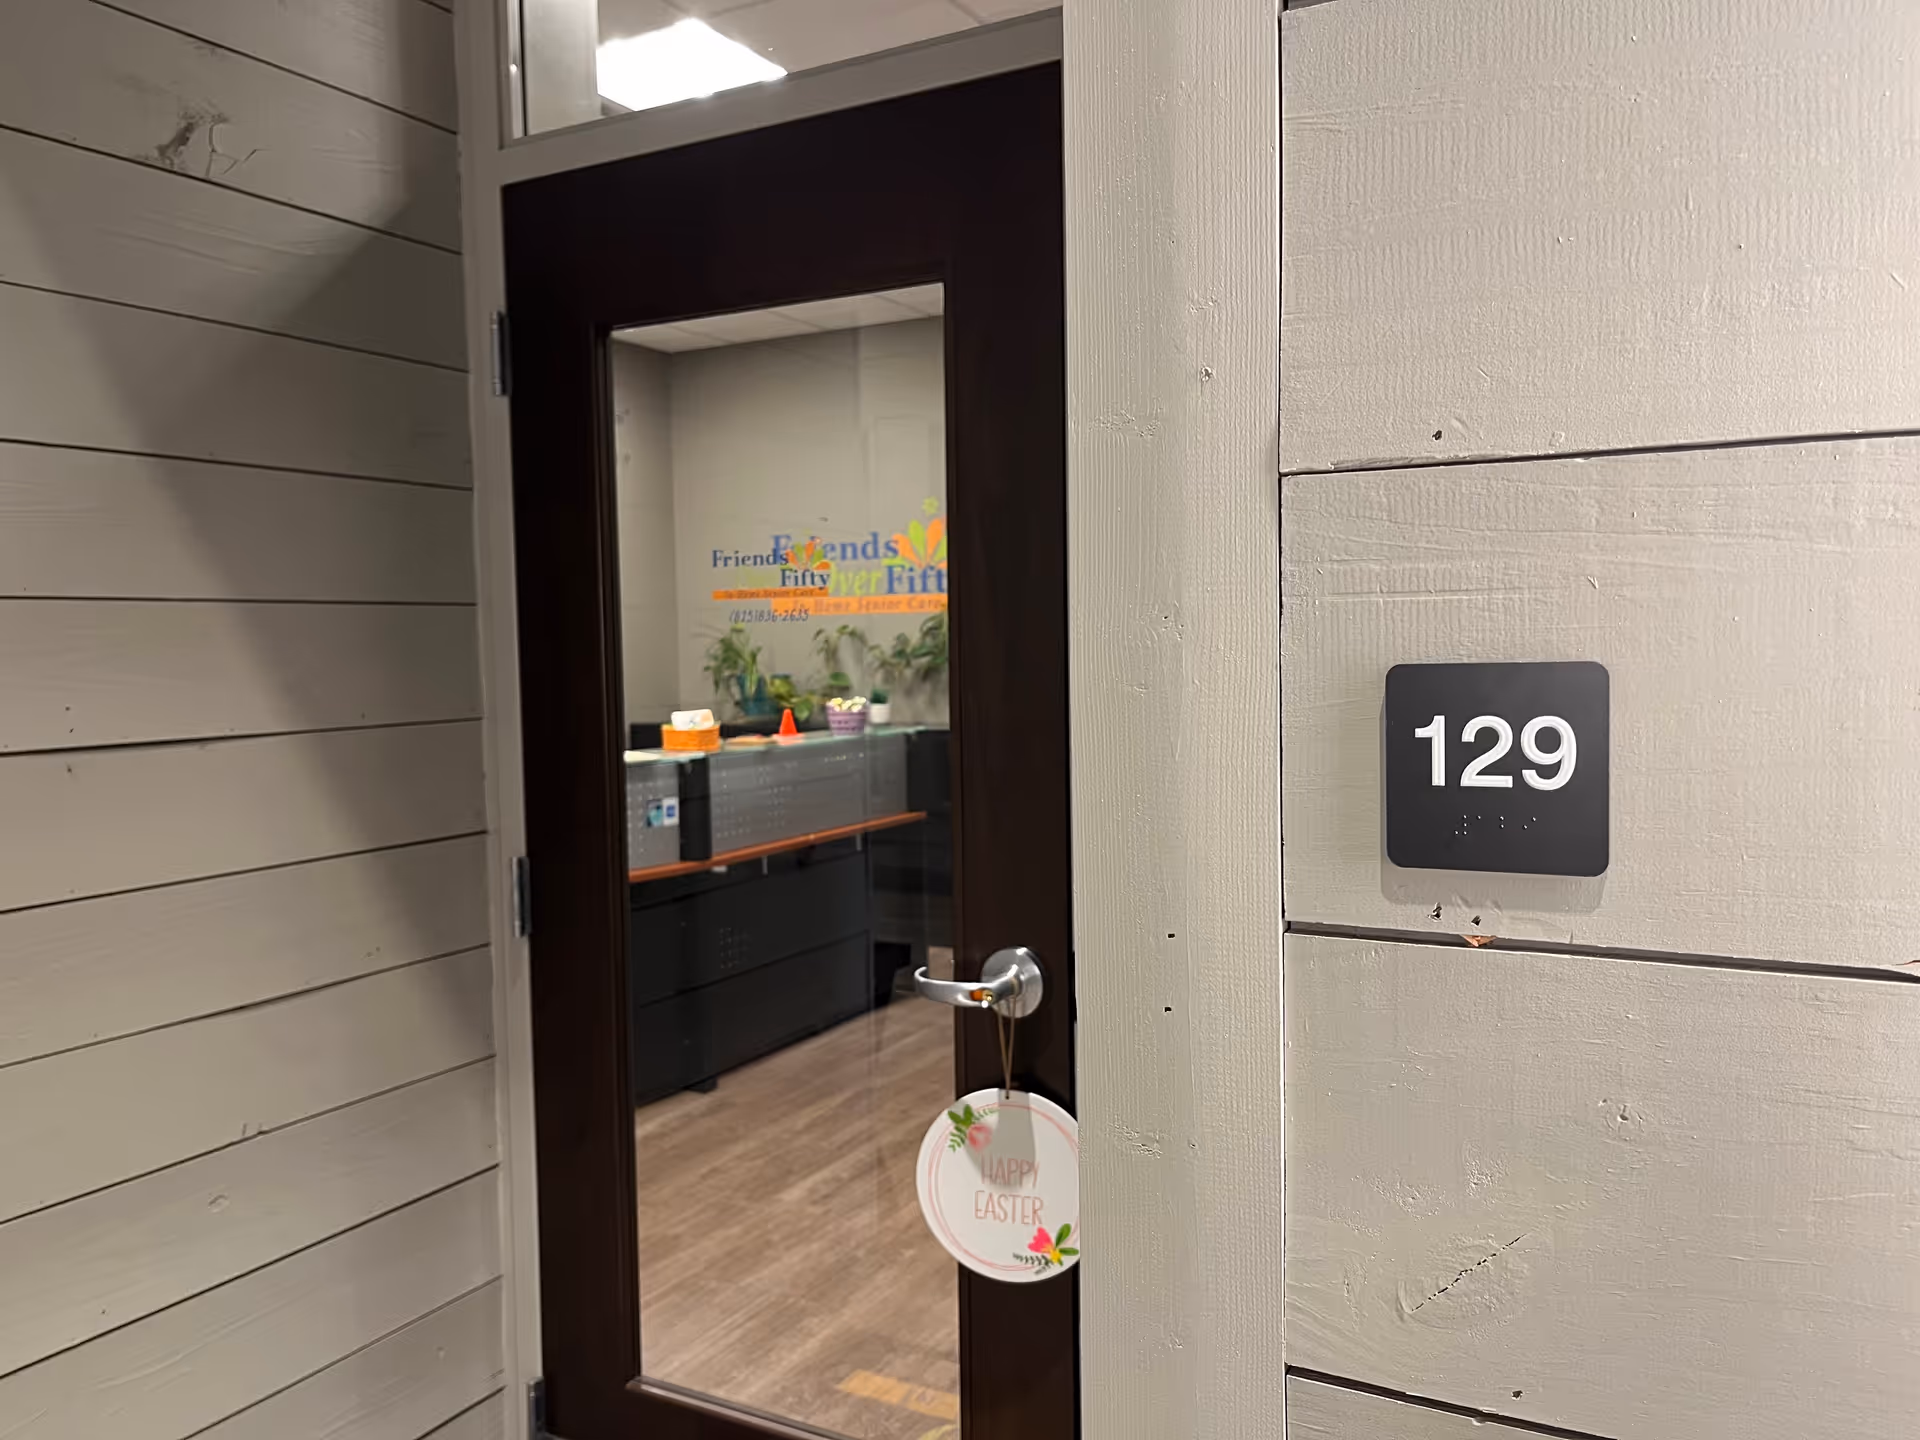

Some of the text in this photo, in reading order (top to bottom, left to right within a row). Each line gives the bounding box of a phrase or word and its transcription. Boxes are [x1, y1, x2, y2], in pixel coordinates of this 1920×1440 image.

[712, 548, 789, 568] Friends
[771, 532, 899, 564] Fends
[780, 568, 831, 590] Fifty
[885, 564, 948, 594] Fift
[1414, 715, 1577, 791] 129
[980, 1152, 1040, 1189] HAPPY
[974, 1190, 1044, 1226] EASTER
